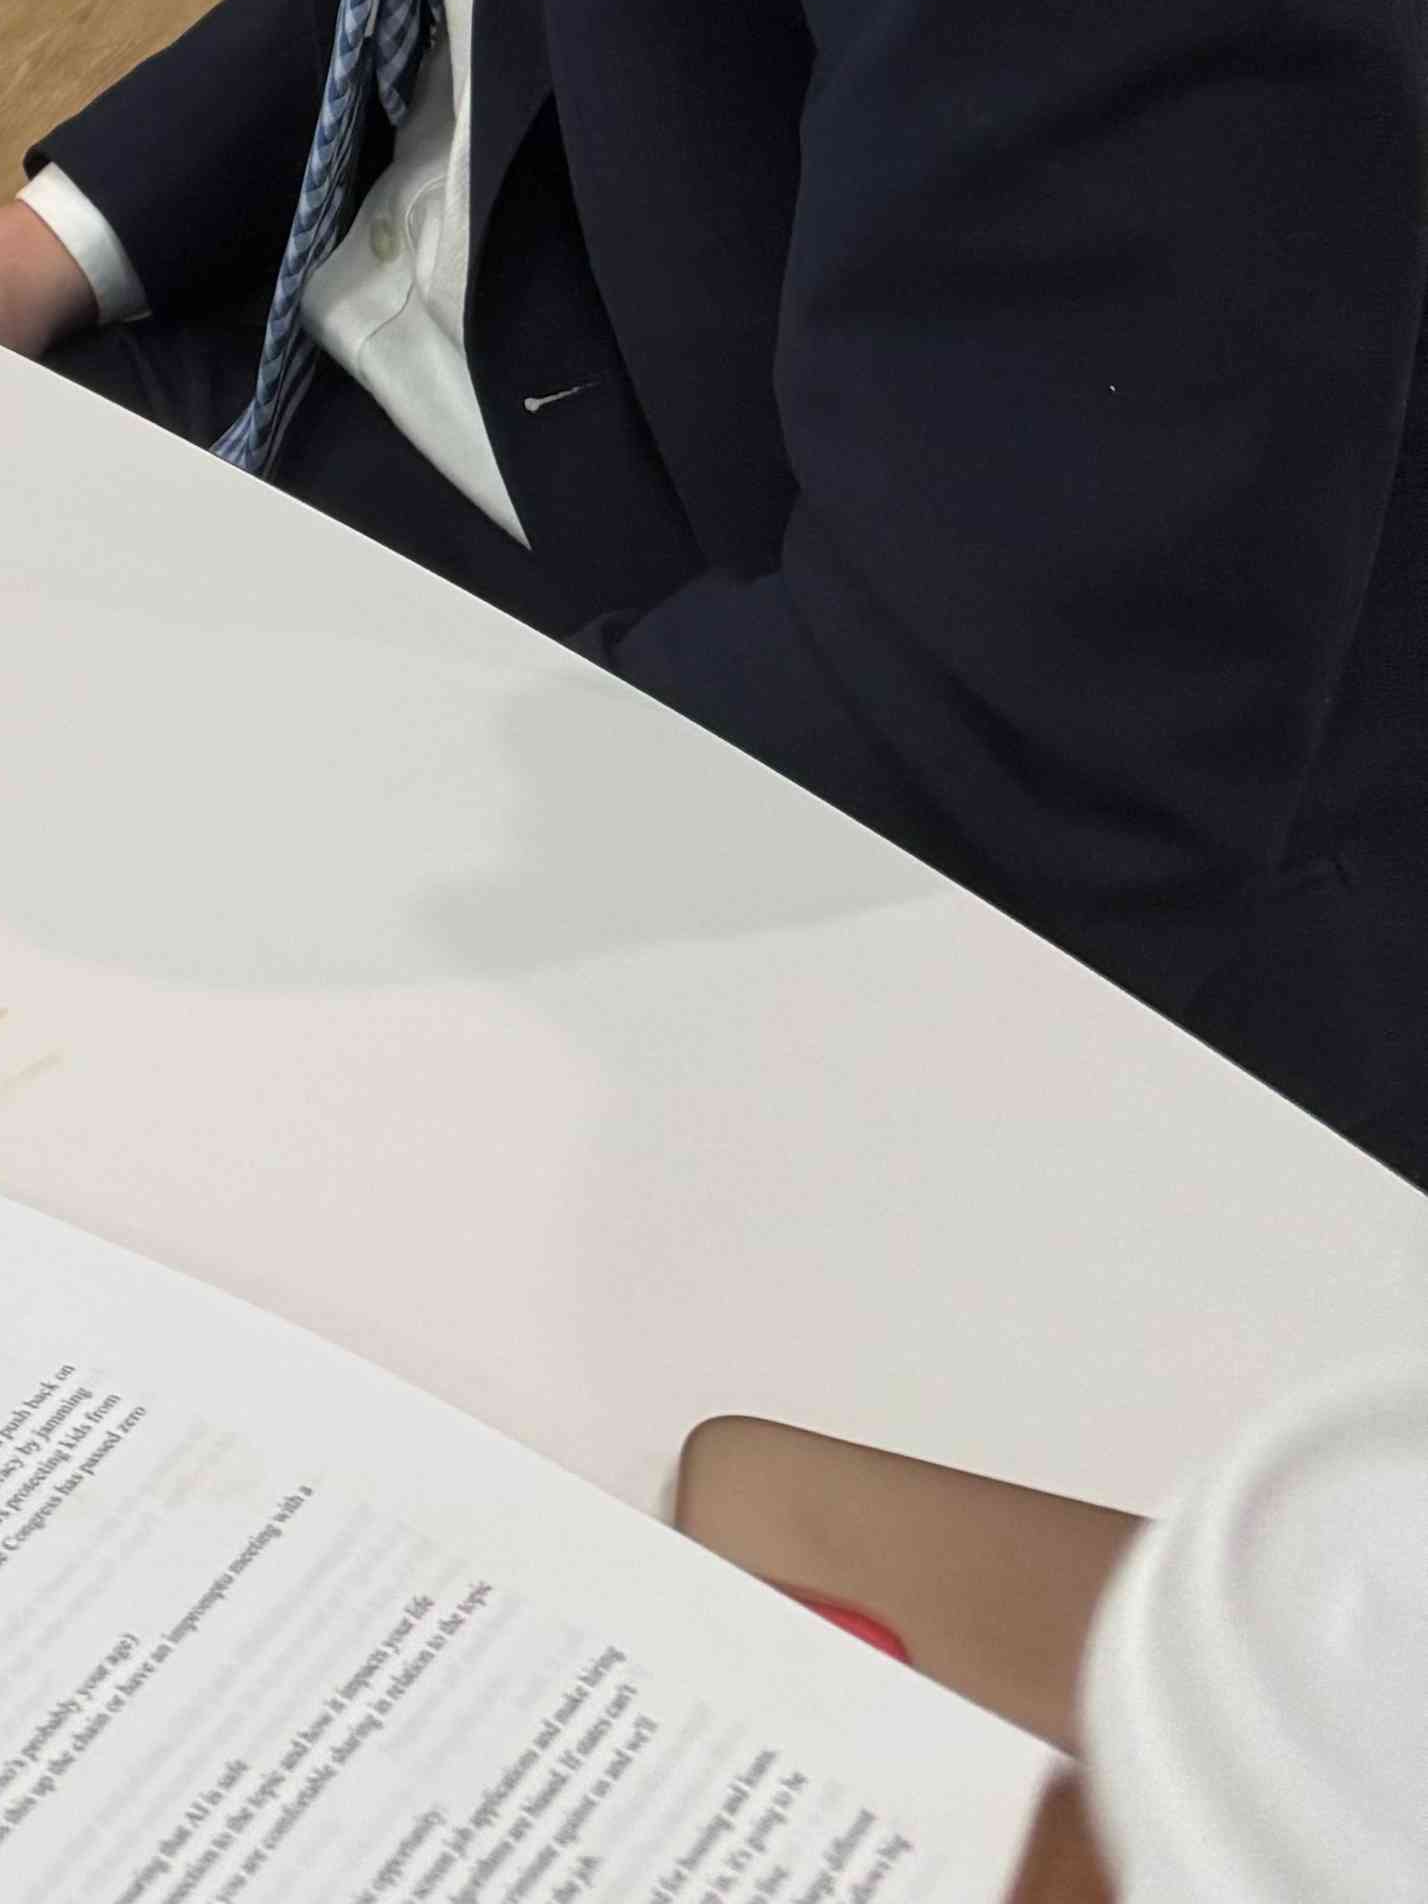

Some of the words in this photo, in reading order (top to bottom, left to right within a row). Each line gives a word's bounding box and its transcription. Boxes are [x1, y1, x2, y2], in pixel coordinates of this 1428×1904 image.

[22, 1378, 59, 1410] back
[53, 1363, 76, 1382] on
[14, 1436, 43, 1457] by
[30, 1384, 94, 1441] jamming
